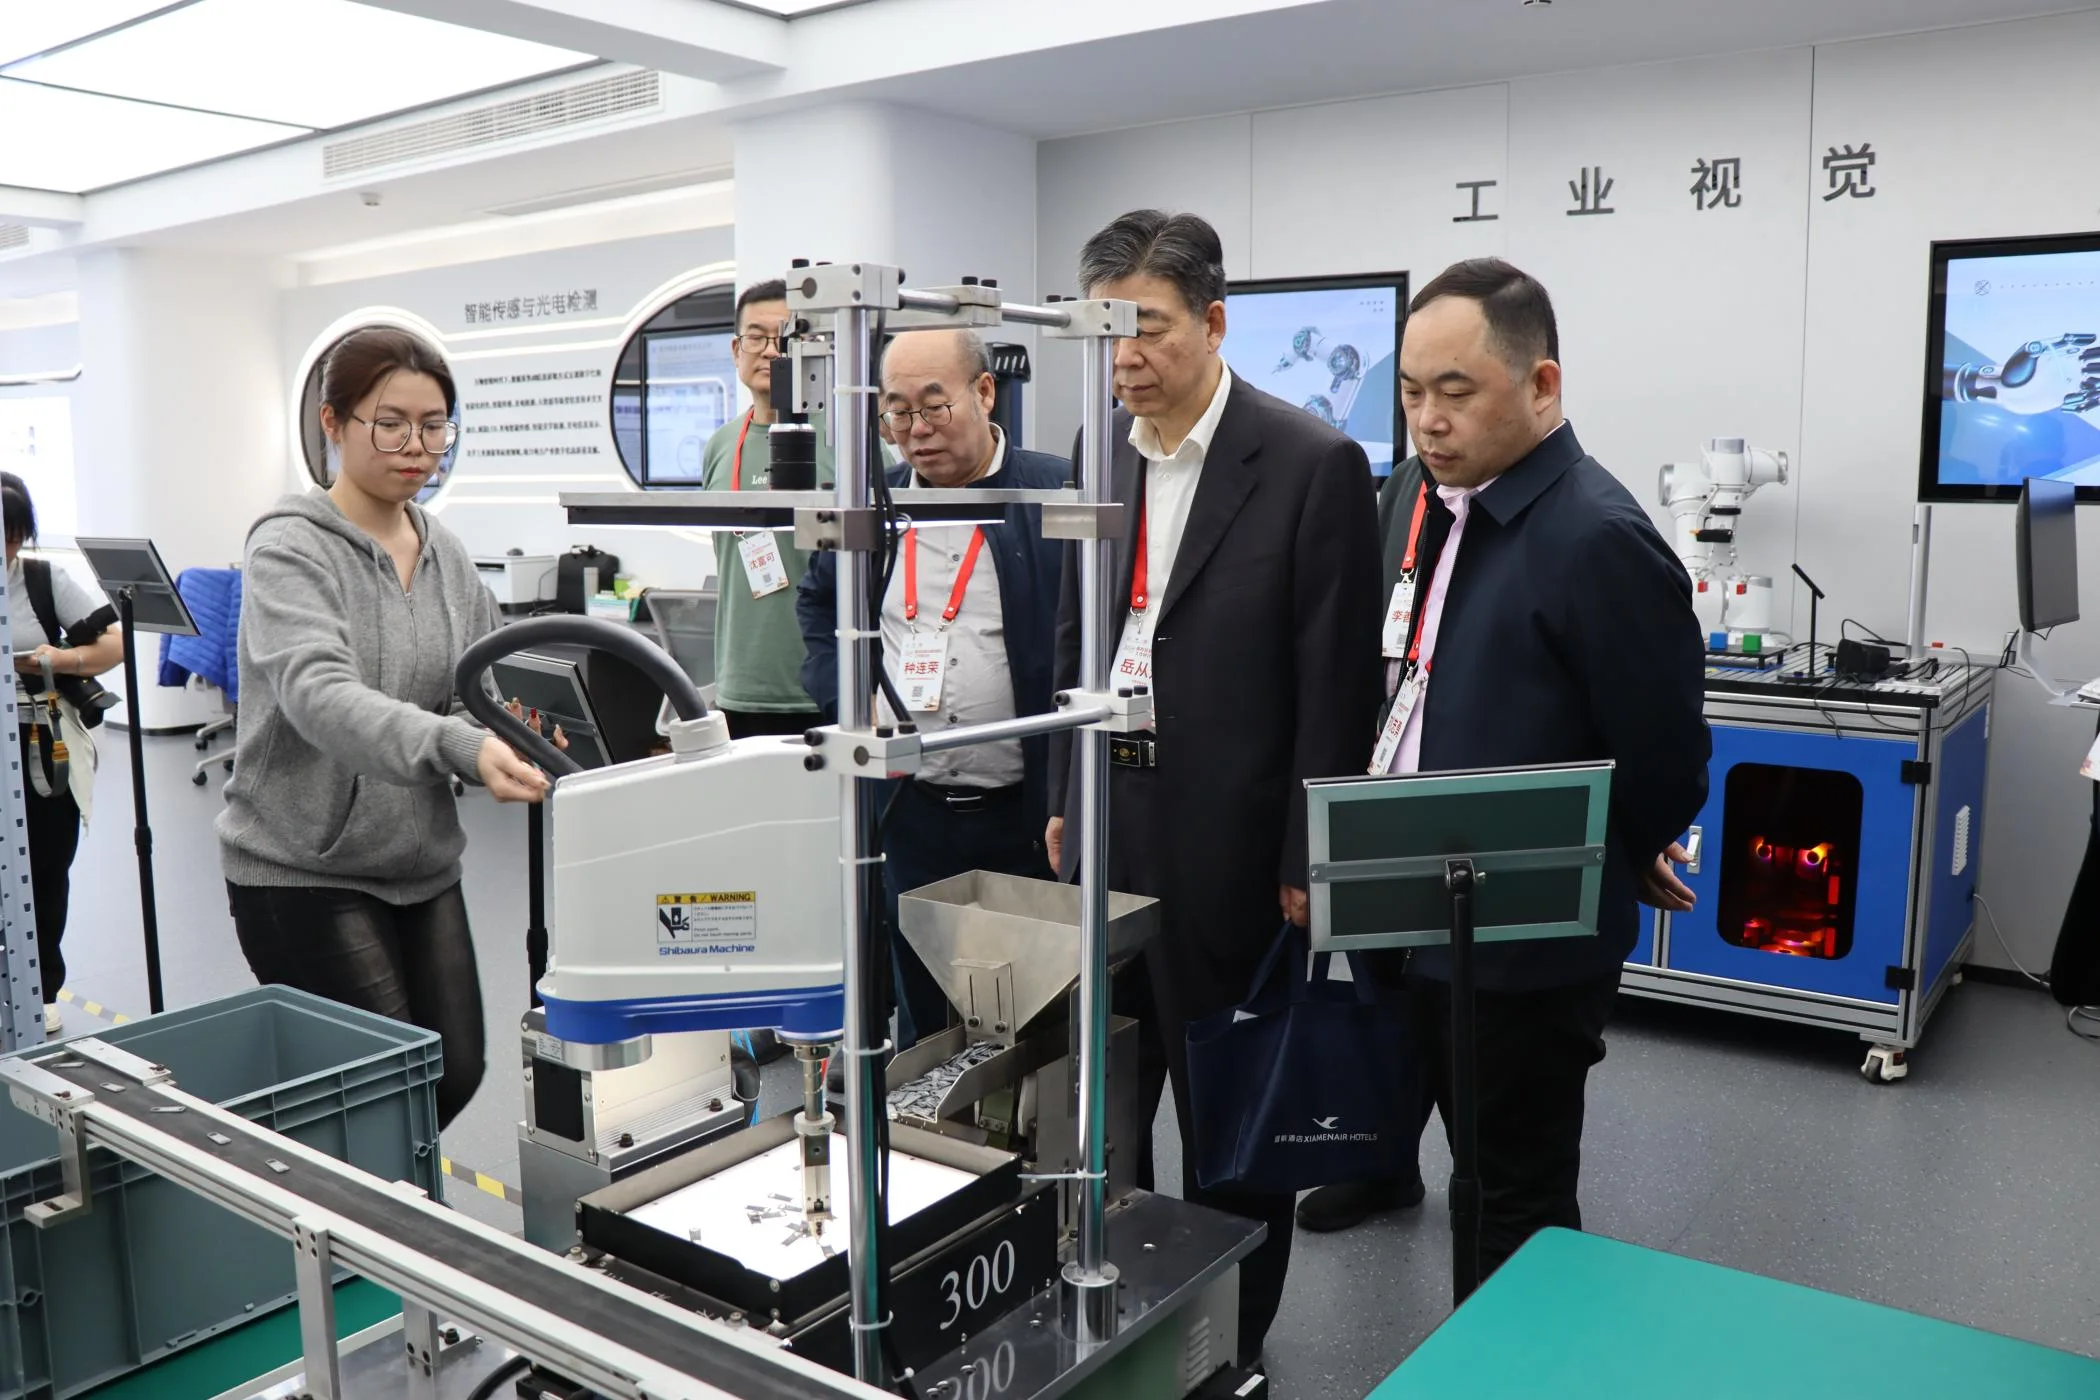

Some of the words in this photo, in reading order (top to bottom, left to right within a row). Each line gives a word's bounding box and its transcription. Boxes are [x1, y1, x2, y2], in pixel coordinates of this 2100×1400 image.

[1453, 143, 1878, 222] 工业视觉
[464, 288, 599, 324] 智能传感与光电检测
[752, 475, 768, 485] Lee
[904, 661, 940, 675] 种连荣
[1120, 658, 1152, 679] 岳从
[710, 893, 751, 903] WARNING
[659, 946, 708, 956] Shibaura
[709, 943, 756, 954] Machine
[1303, 1133, 1348, 1143] XIAMENAIR
[1349, 1133, 1378, 1141] HOTELS
[940, 1240, 1016, 1330] 300
